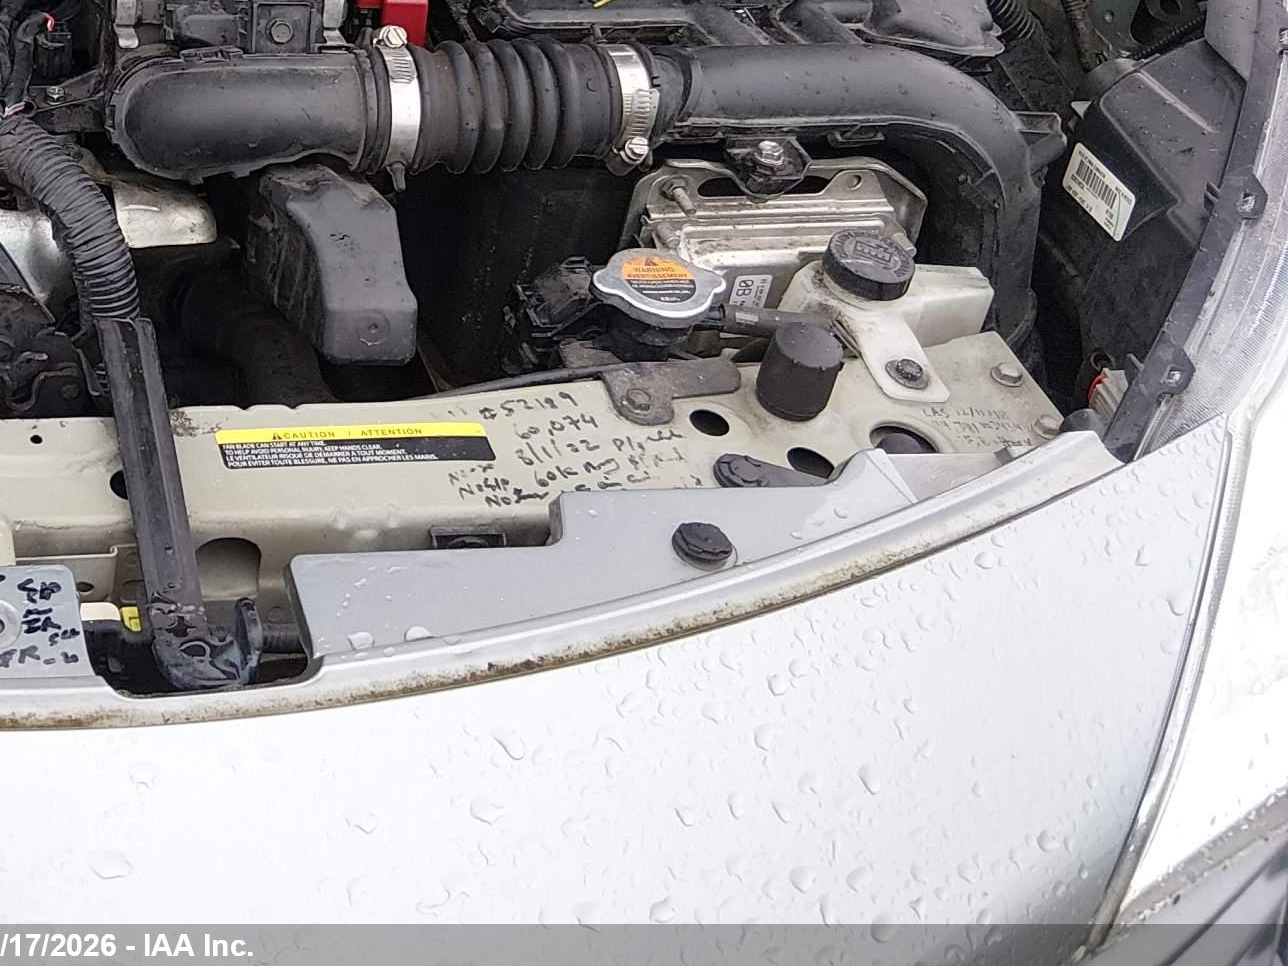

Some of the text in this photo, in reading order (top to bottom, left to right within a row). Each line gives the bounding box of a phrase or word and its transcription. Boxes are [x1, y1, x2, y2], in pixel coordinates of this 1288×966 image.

[283, 431, 335, 439] CAUTION
[361, 428, 423, 437] ATTENTION
[362, 454, 401, 462] APPROCHER
